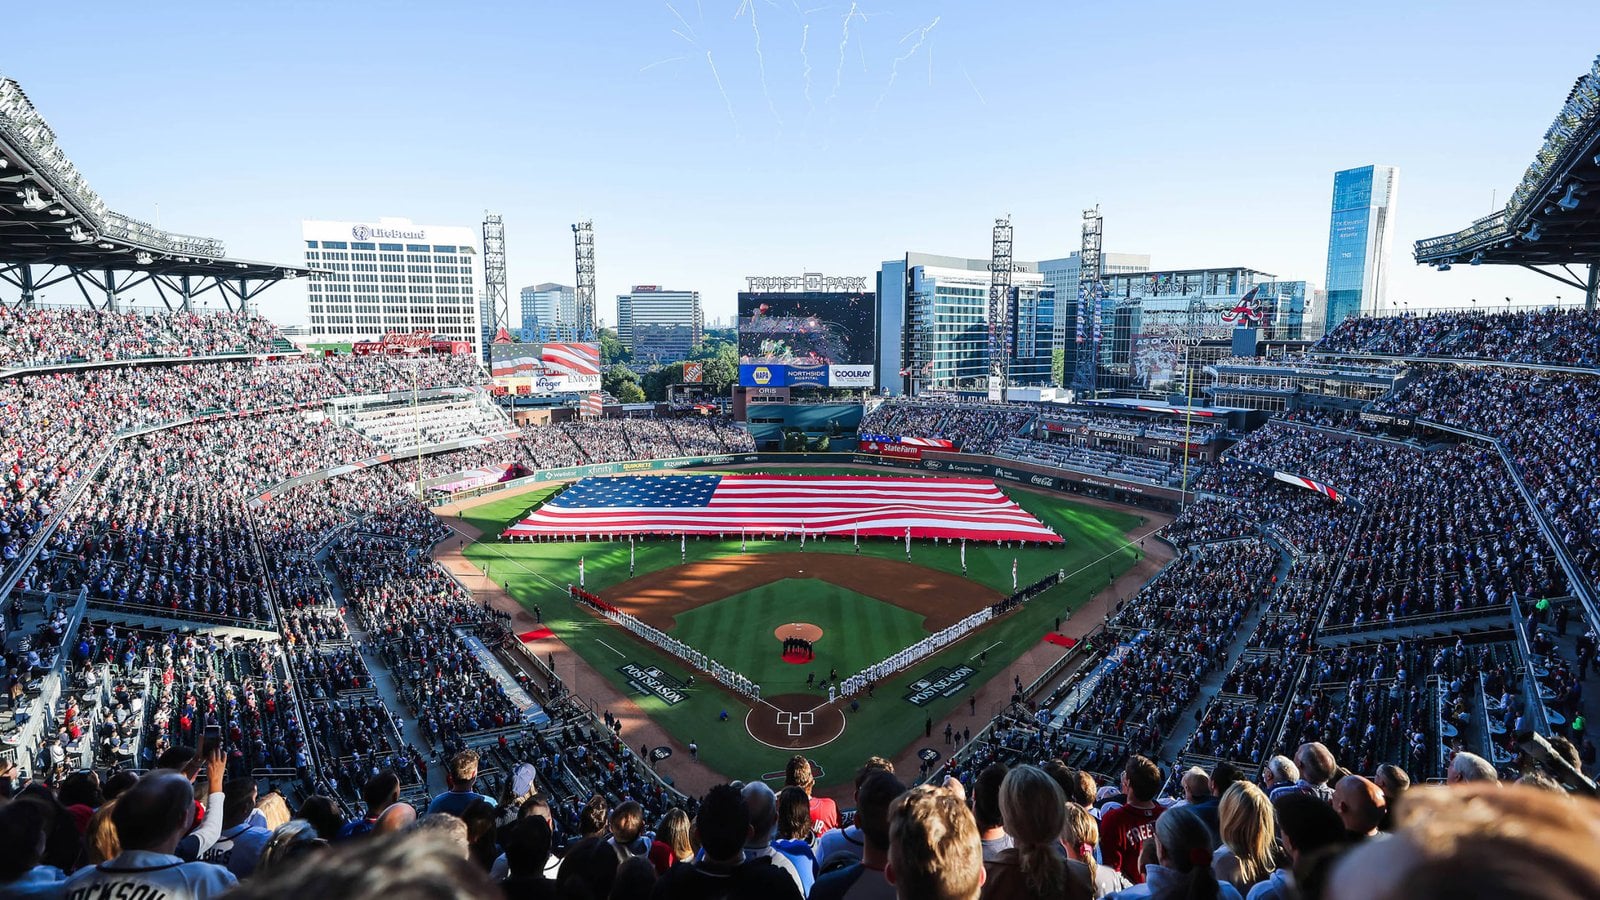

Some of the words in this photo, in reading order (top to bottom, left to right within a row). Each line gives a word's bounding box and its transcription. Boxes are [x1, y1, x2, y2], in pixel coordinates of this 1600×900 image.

[372, 228, 427, 240] LifeBrand
[745, 276, 801, 290] TRUIST
[825, 276, 866, 290] PARK
[520, 326, 595, 342] DELTA
[567, 375, 599, 384] EMORY
[755, 371, 769, 380] NAPA
[835, 370, 872, 378] COOLRAY
[535, 377, 561, 392] Kroger
[1062, 426, 1077, 434] LIGHT
[1094, 430, 1112, 439] CHOP
[1113, 433, 1136, 442] HOUSE
[663, 460, 691, 468] EQUIFAX
[622, 663, 685, 703] POSTSEASON
[908, 665, 974, 704] POSTSEASON
[1126, 820, 1156, 847] FREE
